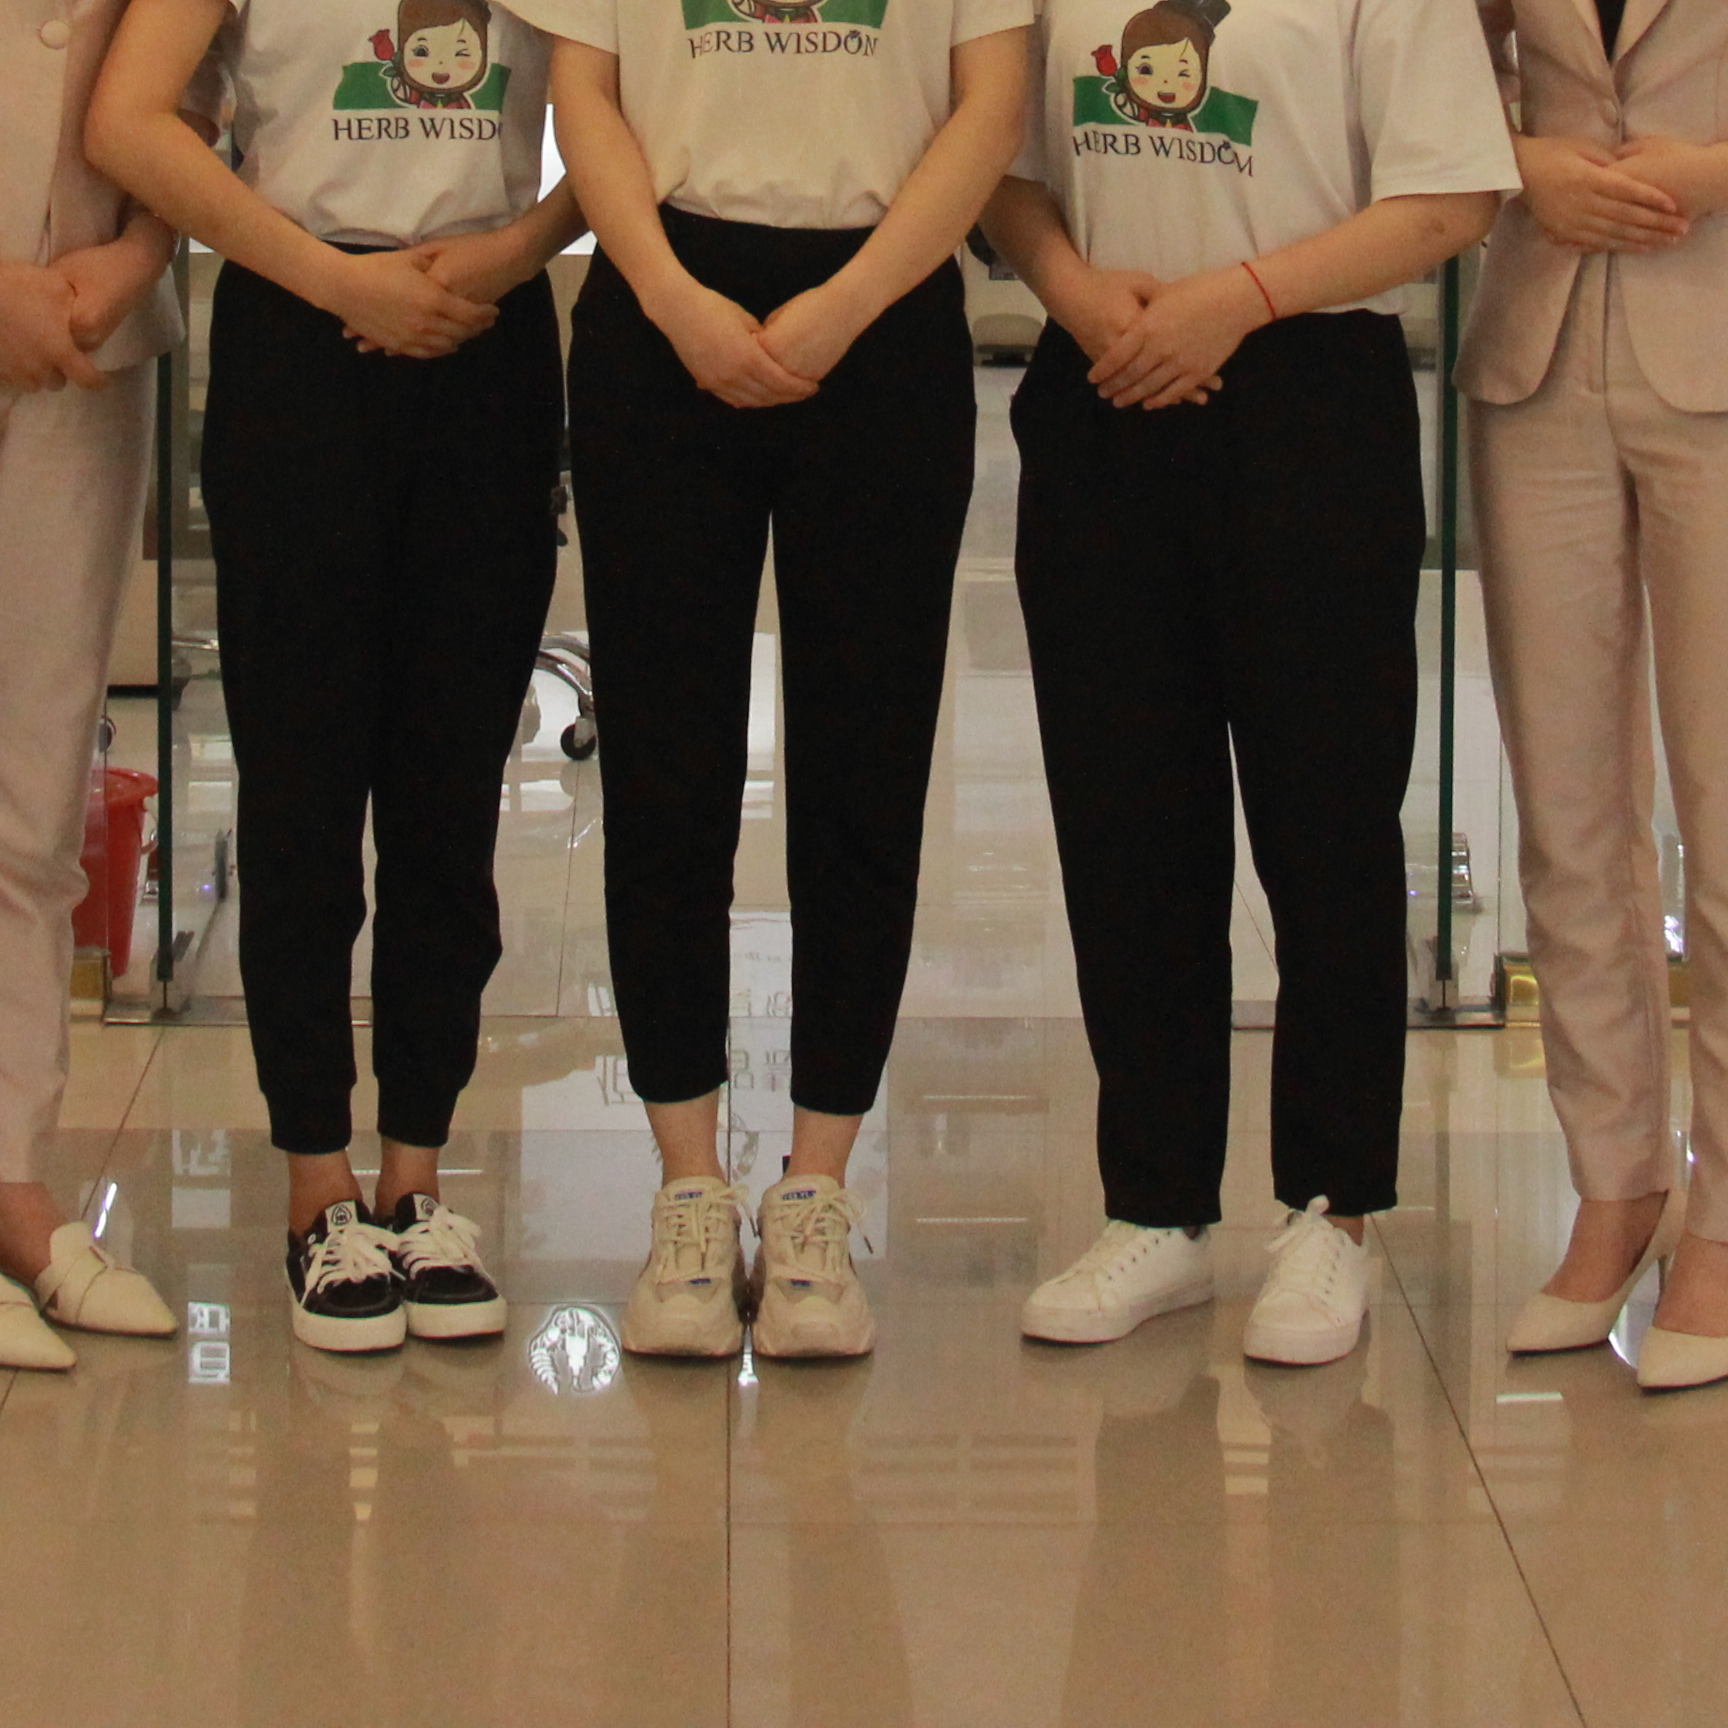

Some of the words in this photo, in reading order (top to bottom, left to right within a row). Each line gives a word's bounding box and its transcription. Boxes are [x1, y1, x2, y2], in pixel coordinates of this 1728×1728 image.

[687, 30, 754, 59] HERB
[331, 116, 410, 141] HERB
[420, 116, 504, 141] WISD
[1072, 130, 1141, 156] HERB
